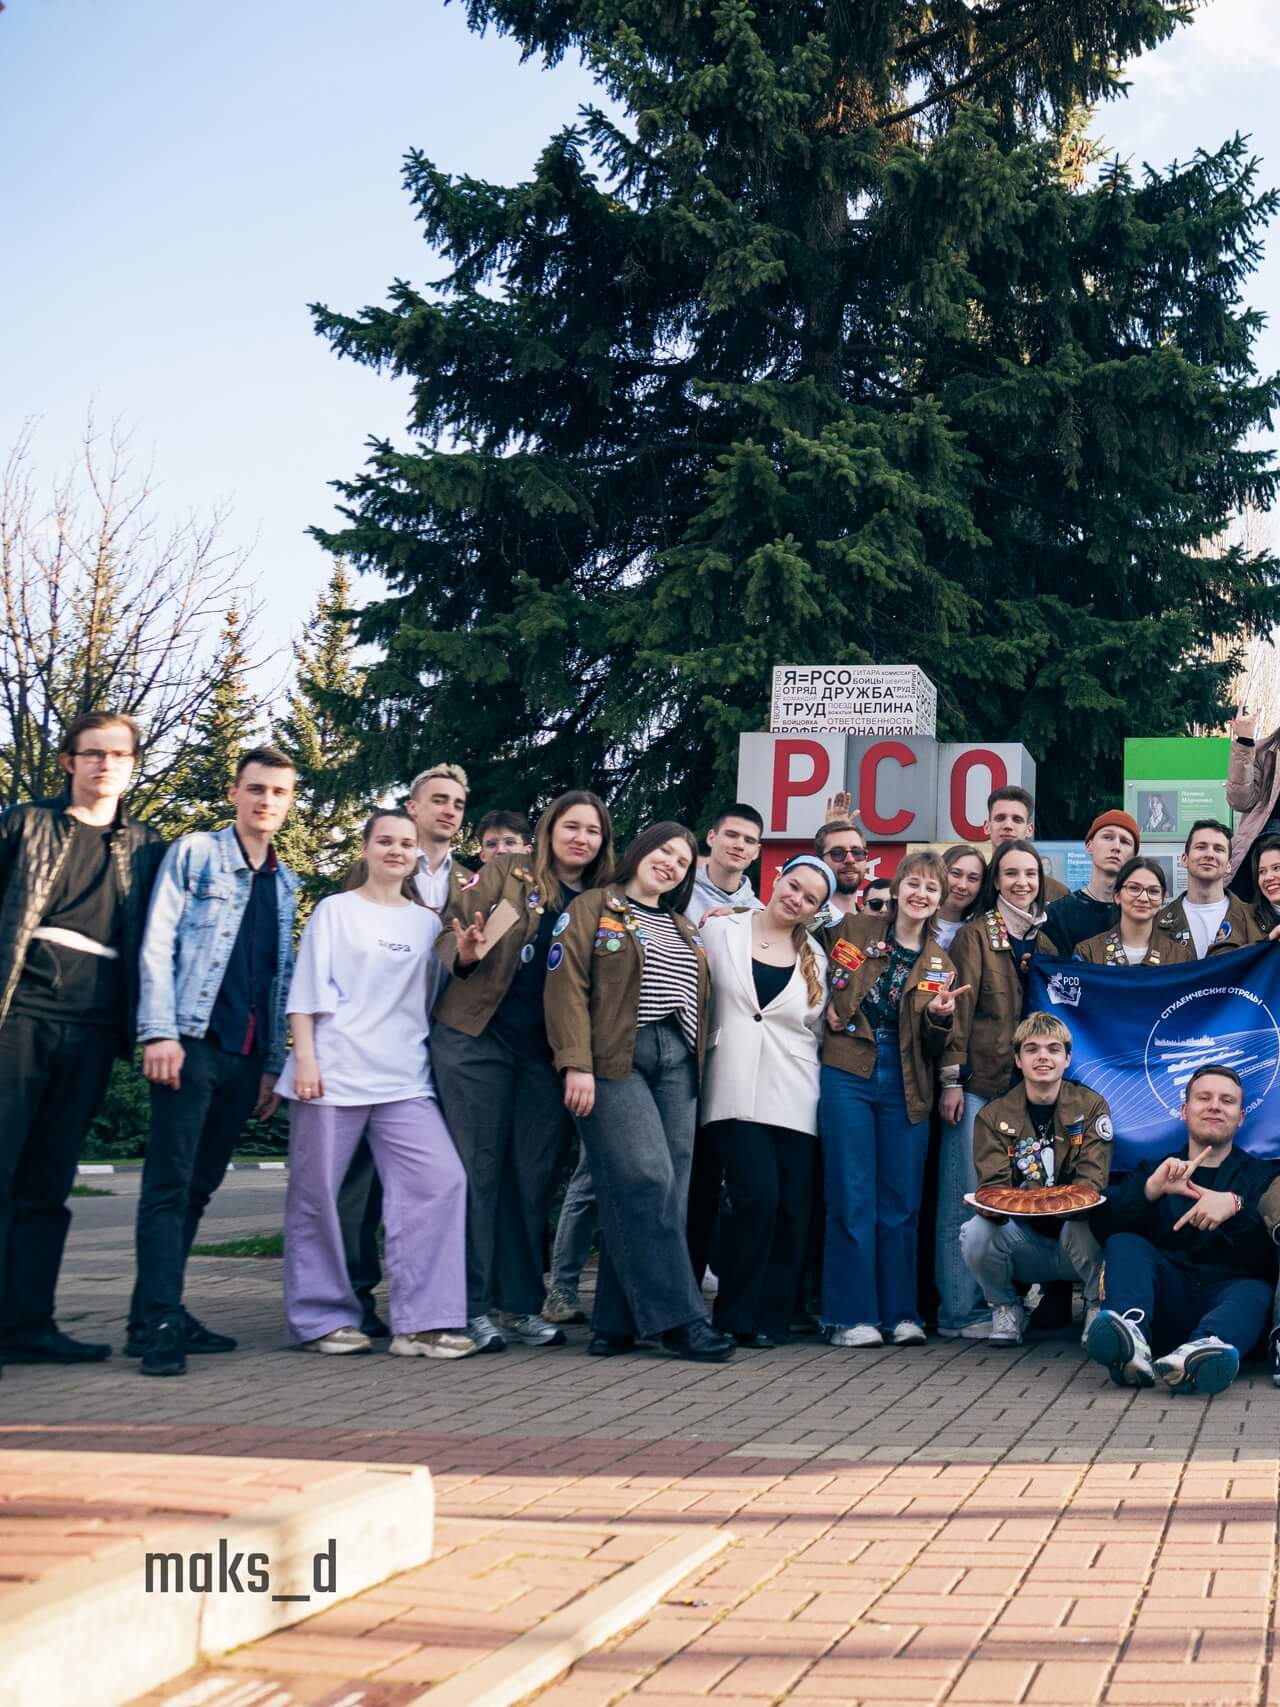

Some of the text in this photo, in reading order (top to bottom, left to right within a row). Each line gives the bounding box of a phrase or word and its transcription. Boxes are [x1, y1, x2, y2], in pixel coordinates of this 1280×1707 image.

[783, 670, 852, 686] Я=РСО
[782, 686, 817, 696] ОТРЯД
[821, 686, 894, 702] ДРУЖБА
[782, 702, 826, 719] ТРУД
[853, 702, 914, 715] ЦЕЛИНА
[827, 717, 913, 725] ОТВЕТСТВЕННОСТЬ
[1063, 976, 1080, 986] РСО
[1160, 986, 1228, 1020] СТУДЕНЧЕСКИЕ
